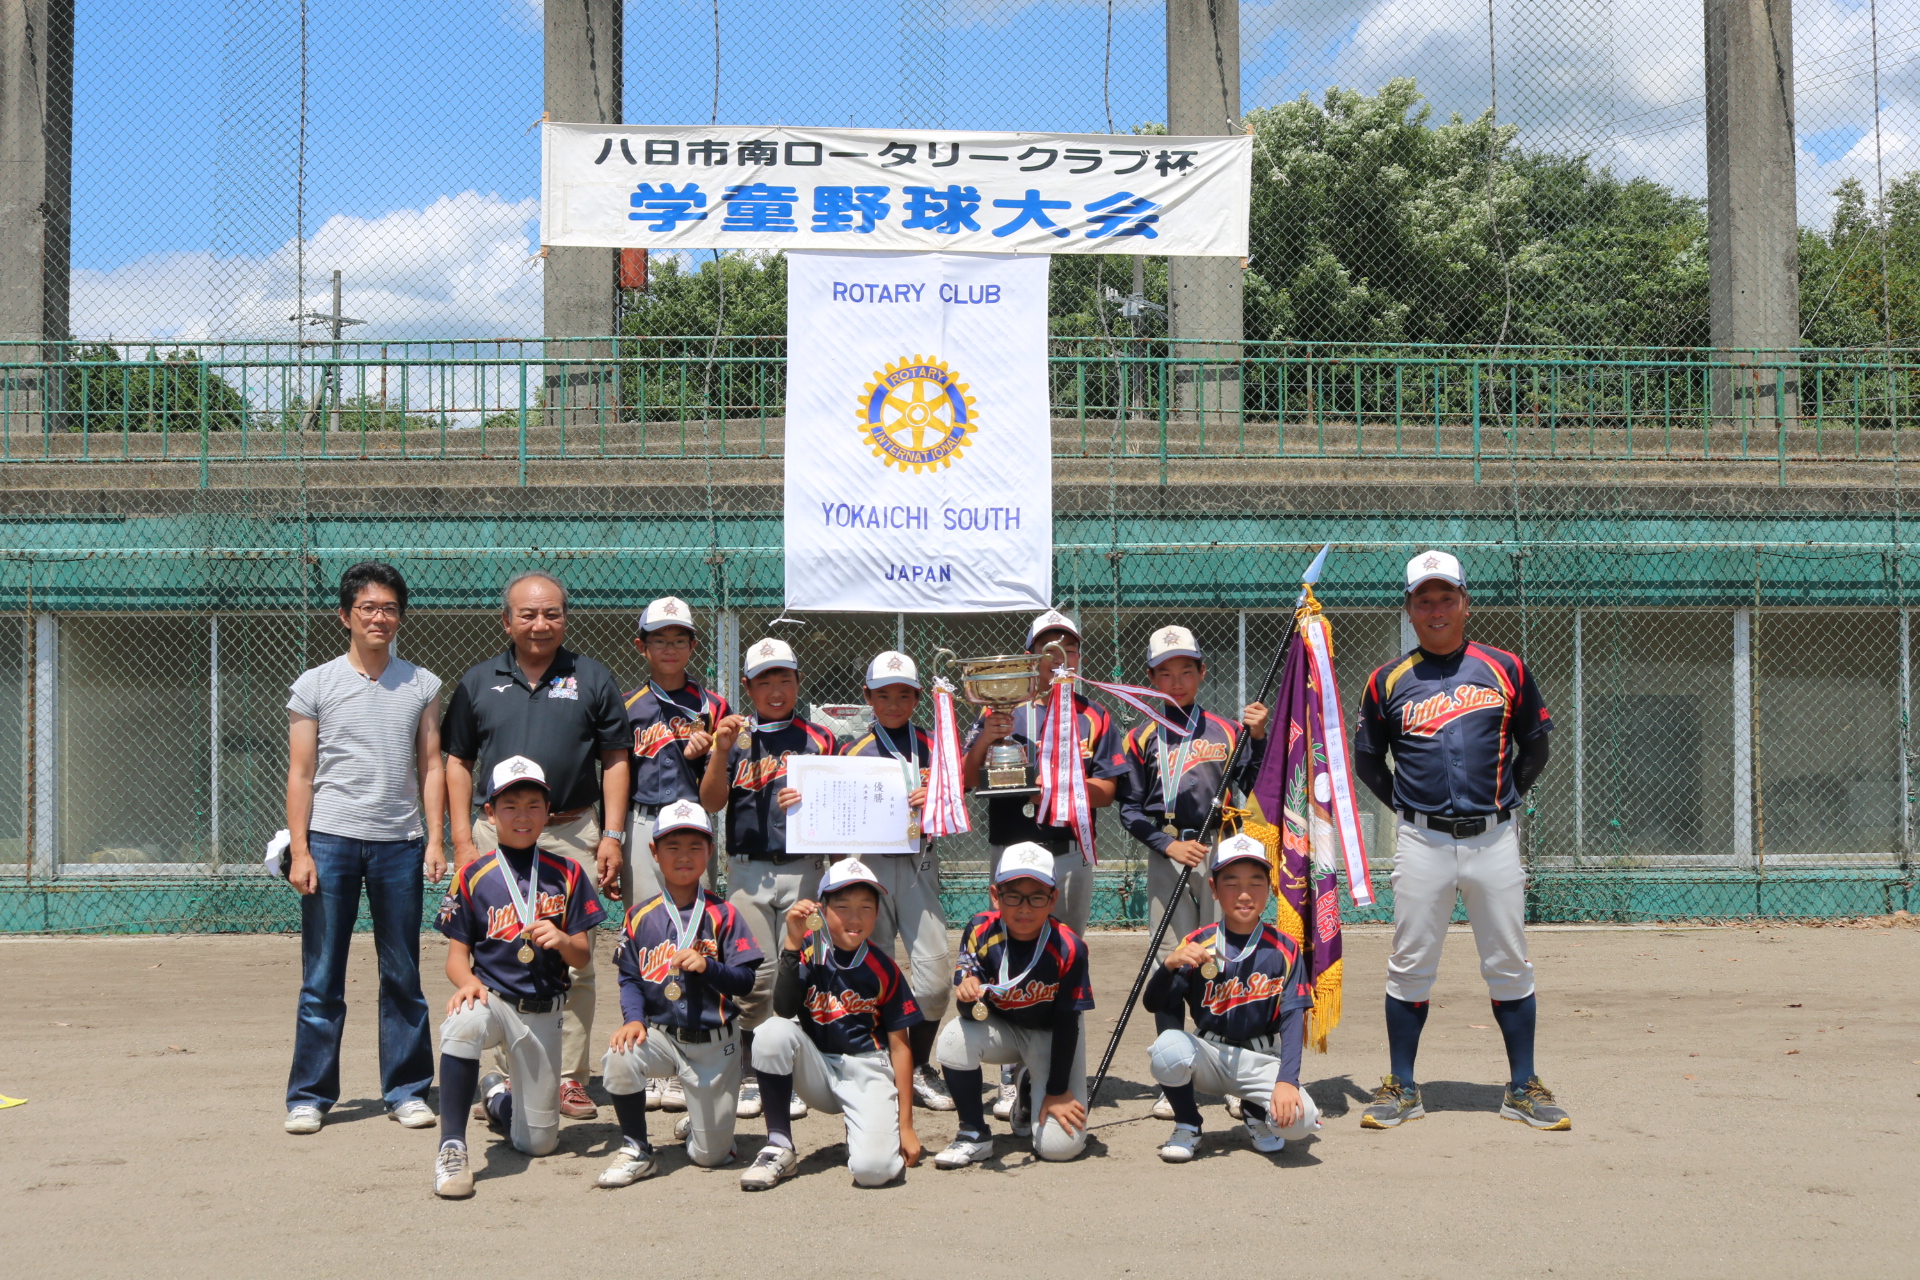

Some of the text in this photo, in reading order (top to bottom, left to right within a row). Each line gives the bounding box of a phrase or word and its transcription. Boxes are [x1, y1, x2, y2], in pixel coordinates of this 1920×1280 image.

[594, 138, 1199, 178] 八日市南ロータリークラブ杯
[628, 182, 1163, 240] 学童野球大会
[833, 281, 1001, 304] ROTARY CLUB
[890, 367, 945, 385] ROTARY
[874, 430, 962, 462] INTERNATIONAL
[821, 502, 1020, 531] YOKAICHI SOUTH
[884, 564, 951, 583] JAPAN
[1401, 684, 1505, 736] Little Stars
[633, 720, 673, 755] Little
[1191, 738, 1228, 762] Stars
[732, 754, 778, 788] Little
[873, 781, 884, 804] 優勝
[639, 938, 678, 979] Little
[1201, 975, 1244, 1008] Little
[1244, 971, 1284, 997] Stars
